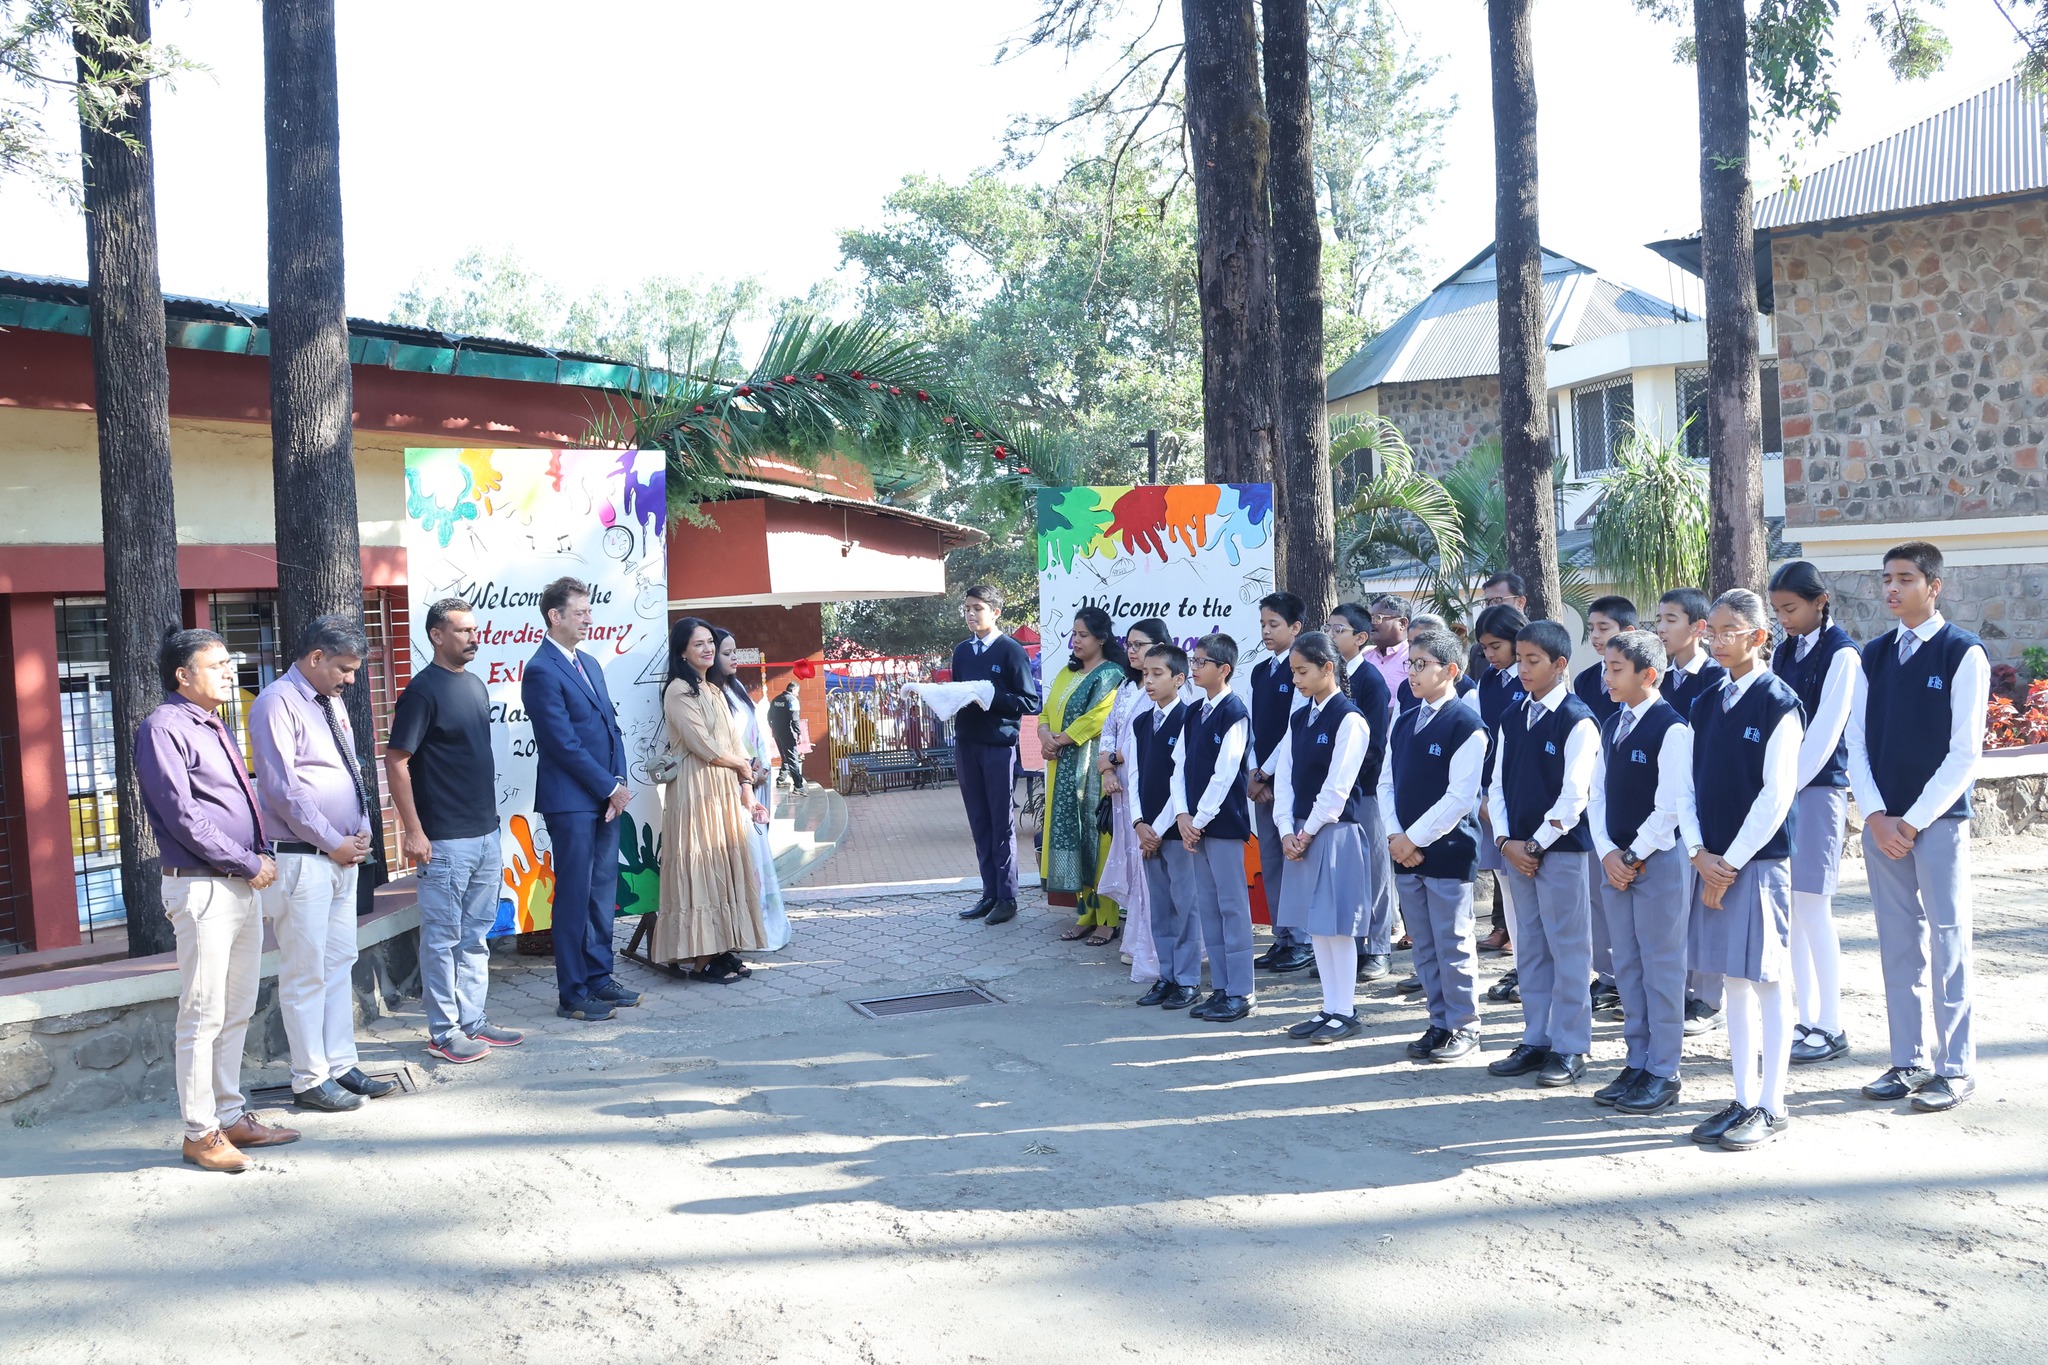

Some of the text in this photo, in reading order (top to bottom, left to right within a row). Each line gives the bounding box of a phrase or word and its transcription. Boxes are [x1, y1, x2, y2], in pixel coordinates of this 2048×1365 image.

[459, 581, 542, 610] Welcom
[1178, 597, 1197, 618] to
[1203, 597, 1232, 618] the
